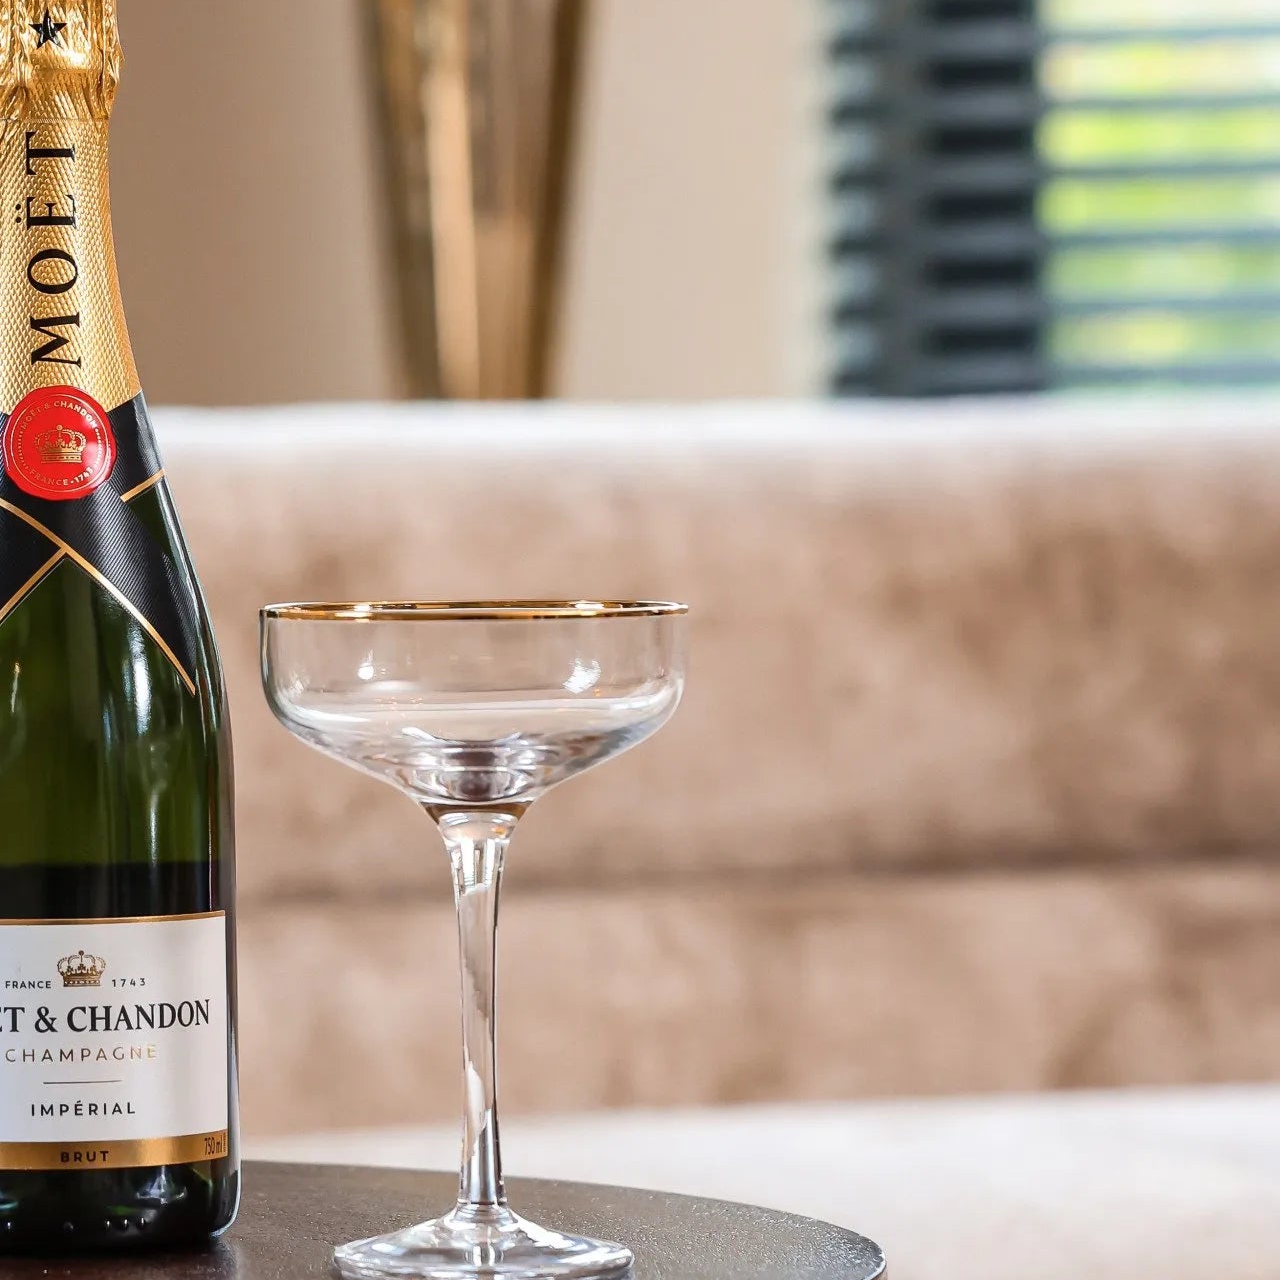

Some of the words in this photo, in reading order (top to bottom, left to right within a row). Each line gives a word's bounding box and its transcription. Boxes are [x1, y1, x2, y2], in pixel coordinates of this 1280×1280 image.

[14, 131, 81, 368] MOËT
[53, 400, 98, 429] CHANDON
[28, 469, 69, 486] FRANCE
[5, 979, 52, 989] FRANCE
[111, 977, 146, 988] 1743
[34, 1006, 58, 1033] &
[67, 999, 210, 1033] CHANDON
[5, 1044, 157, 1063] CHAMPAGNE
[31, 1100, 136, 1117] IMPÉRIAL
[204, 1137, 215, 1155] 750
[60, 1150, 110, 1163] BRUT
